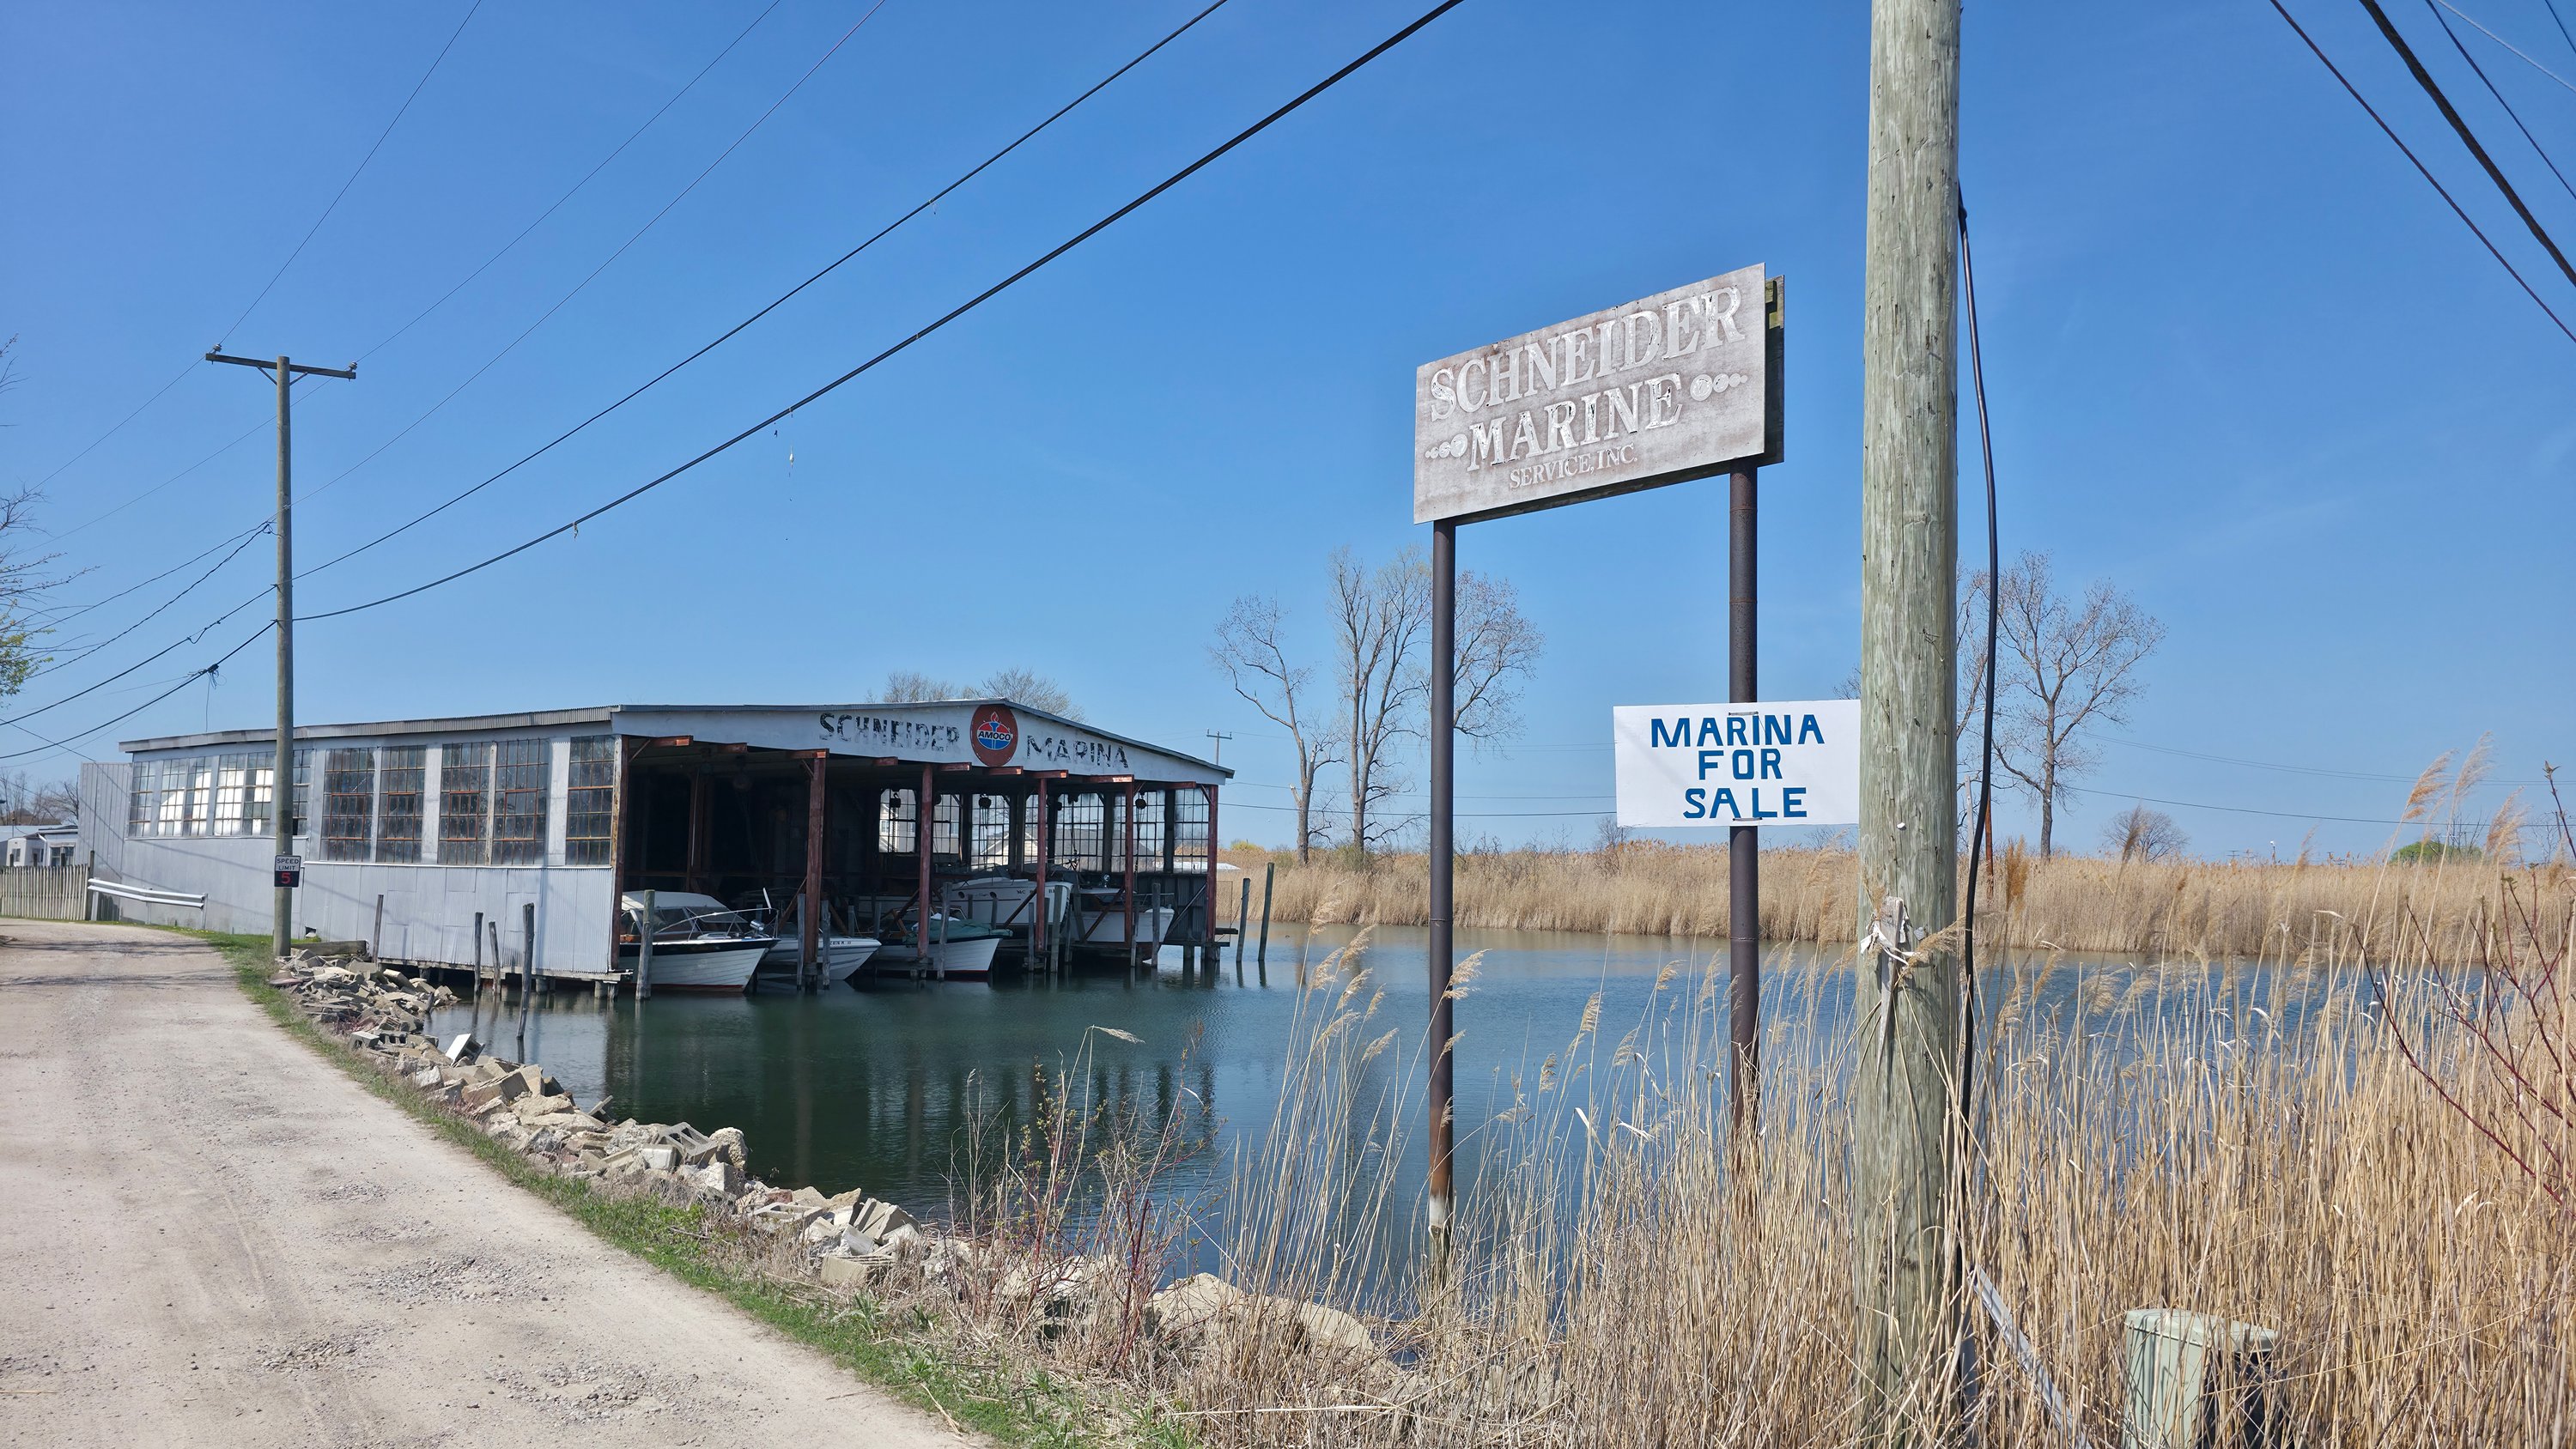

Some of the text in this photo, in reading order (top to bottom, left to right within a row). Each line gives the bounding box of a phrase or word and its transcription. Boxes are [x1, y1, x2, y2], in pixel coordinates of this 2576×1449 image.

[1430, 285, 1746, 421] SCHNEIDER
[1467, 373, 1682, 472] MARINE
[1596, 442, 1638, 470] INC.
[819, 712, 960, 753] SCHNEIDER
[978, 731, 1011, 741] AMOCO
[1651, 714, 1826, 748] MARINA
[1026, 735, 1129, 769] MARINA
[1698, 749, 1783, 780] FOR
[1683, 787, 1807, 819] SALE
[281, 871, 291, 884] 5
